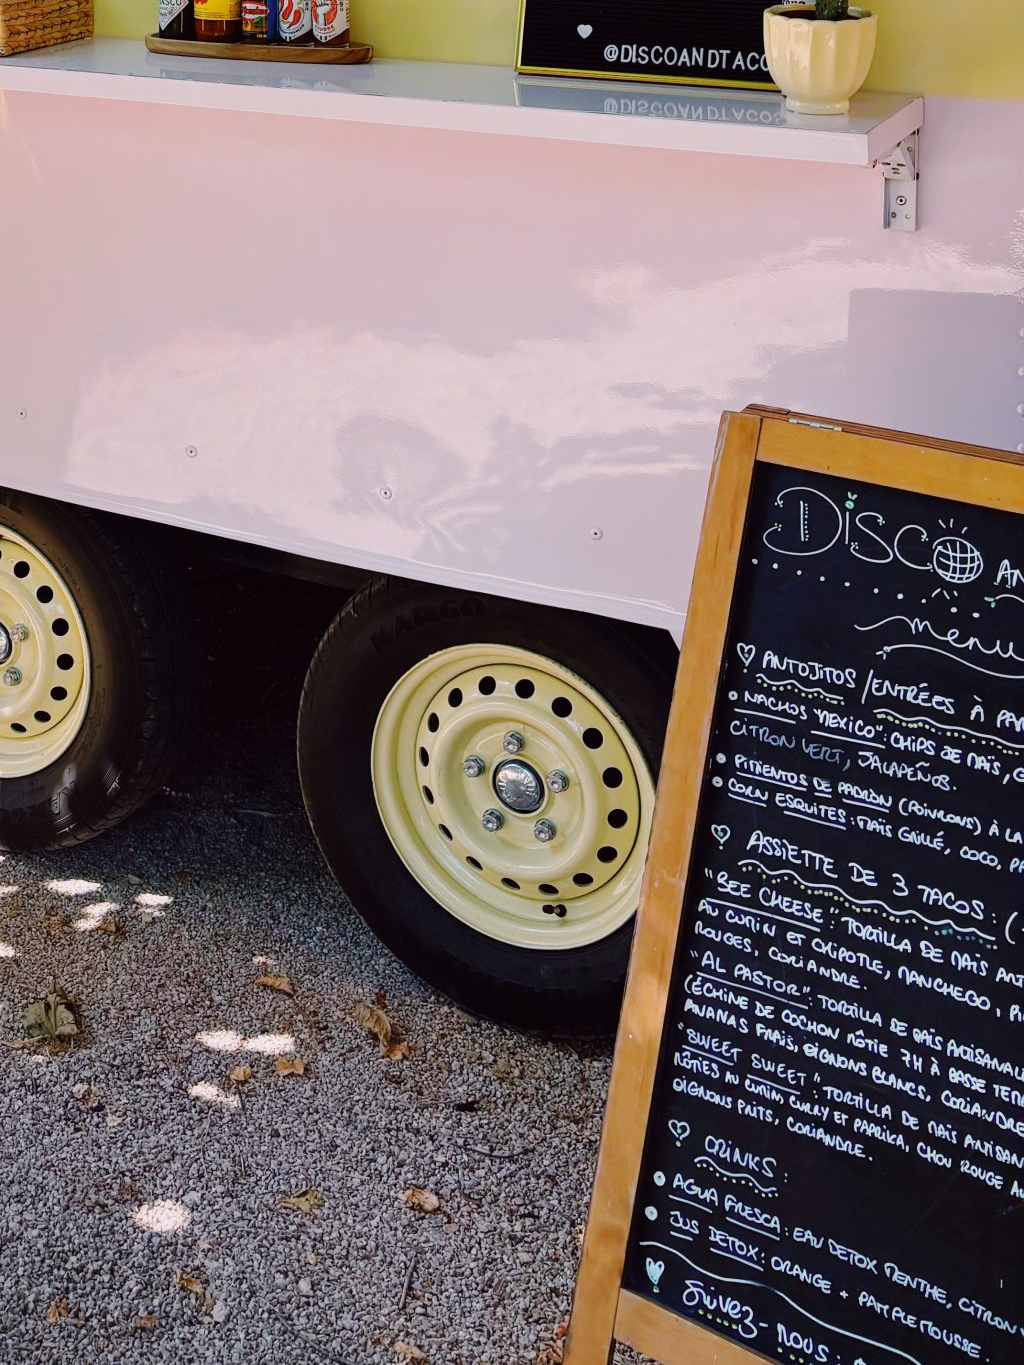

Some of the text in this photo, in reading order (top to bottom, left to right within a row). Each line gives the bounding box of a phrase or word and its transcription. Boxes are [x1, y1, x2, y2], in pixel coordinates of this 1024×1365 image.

[744, 691, 808, 720] NACHOS
[728, 777, 769, 801] CORN
[813, 777, 833, 793] DE
[848, 862, 878, 887] DE
[892, 873, 909, 896] 3
[697, 899, 719, 917] AU
[786, 930, 806, 947] ET
[919, 940, 944, 963] DE
[684, 998, 749, 1033] ANANAS
[889, 1017, 908, 1037] DE
[754, 1001, 775, 1019] DE
[781, 1009, 840, 1040] COCHON
[948, 1067, 986, 1093] BASSE
[725, 1070, 739, 1085] AU
[834, 1111, 849, 1126] ET
[916, 1142, 952, 1168] CHOU
[960, 1159, 1004, 1190] ROUGE
[901, 1110, 920, 1131] DE
[672, 1173, 719, 1206] AGUA
[793, 1227, 824, 1249] EAU
[828, 1238, 878, 1274] DETOX
[669, 1211, 700, 1234] JUS
[770, 1256, 832, 1294] ORANGE
